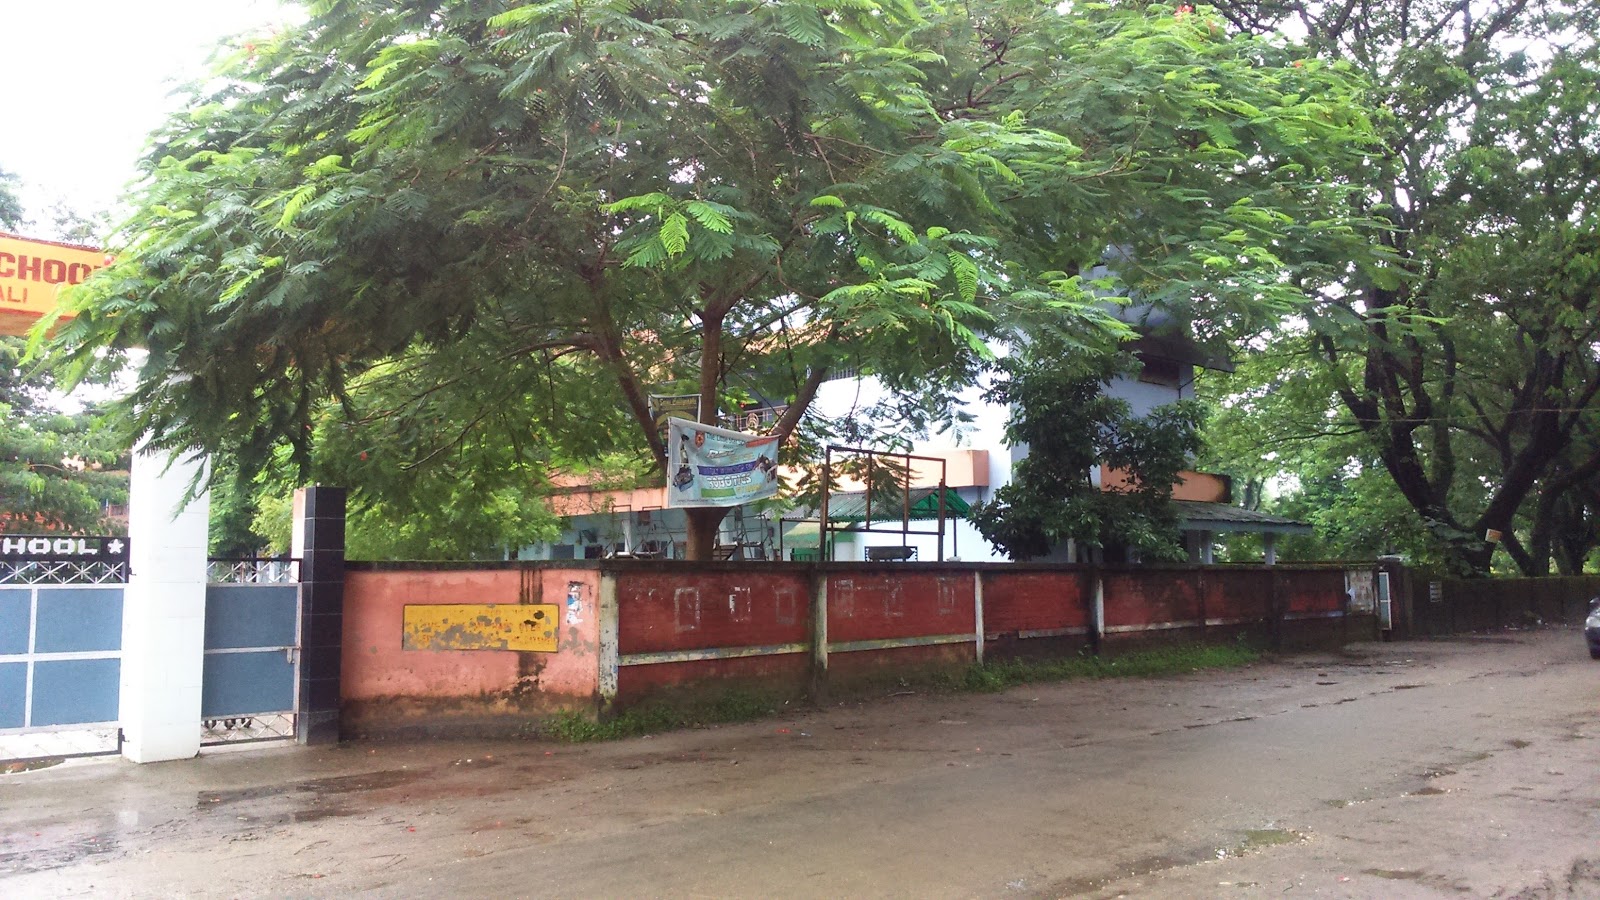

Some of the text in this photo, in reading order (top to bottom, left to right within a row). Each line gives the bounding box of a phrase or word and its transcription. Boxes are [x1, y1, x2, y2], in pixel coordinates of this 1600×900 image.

[0, 252, 101, 285] CHOO
[706, 473, 752, 489] ROBOTICS
[2, 537, 98, 555] HOOL
